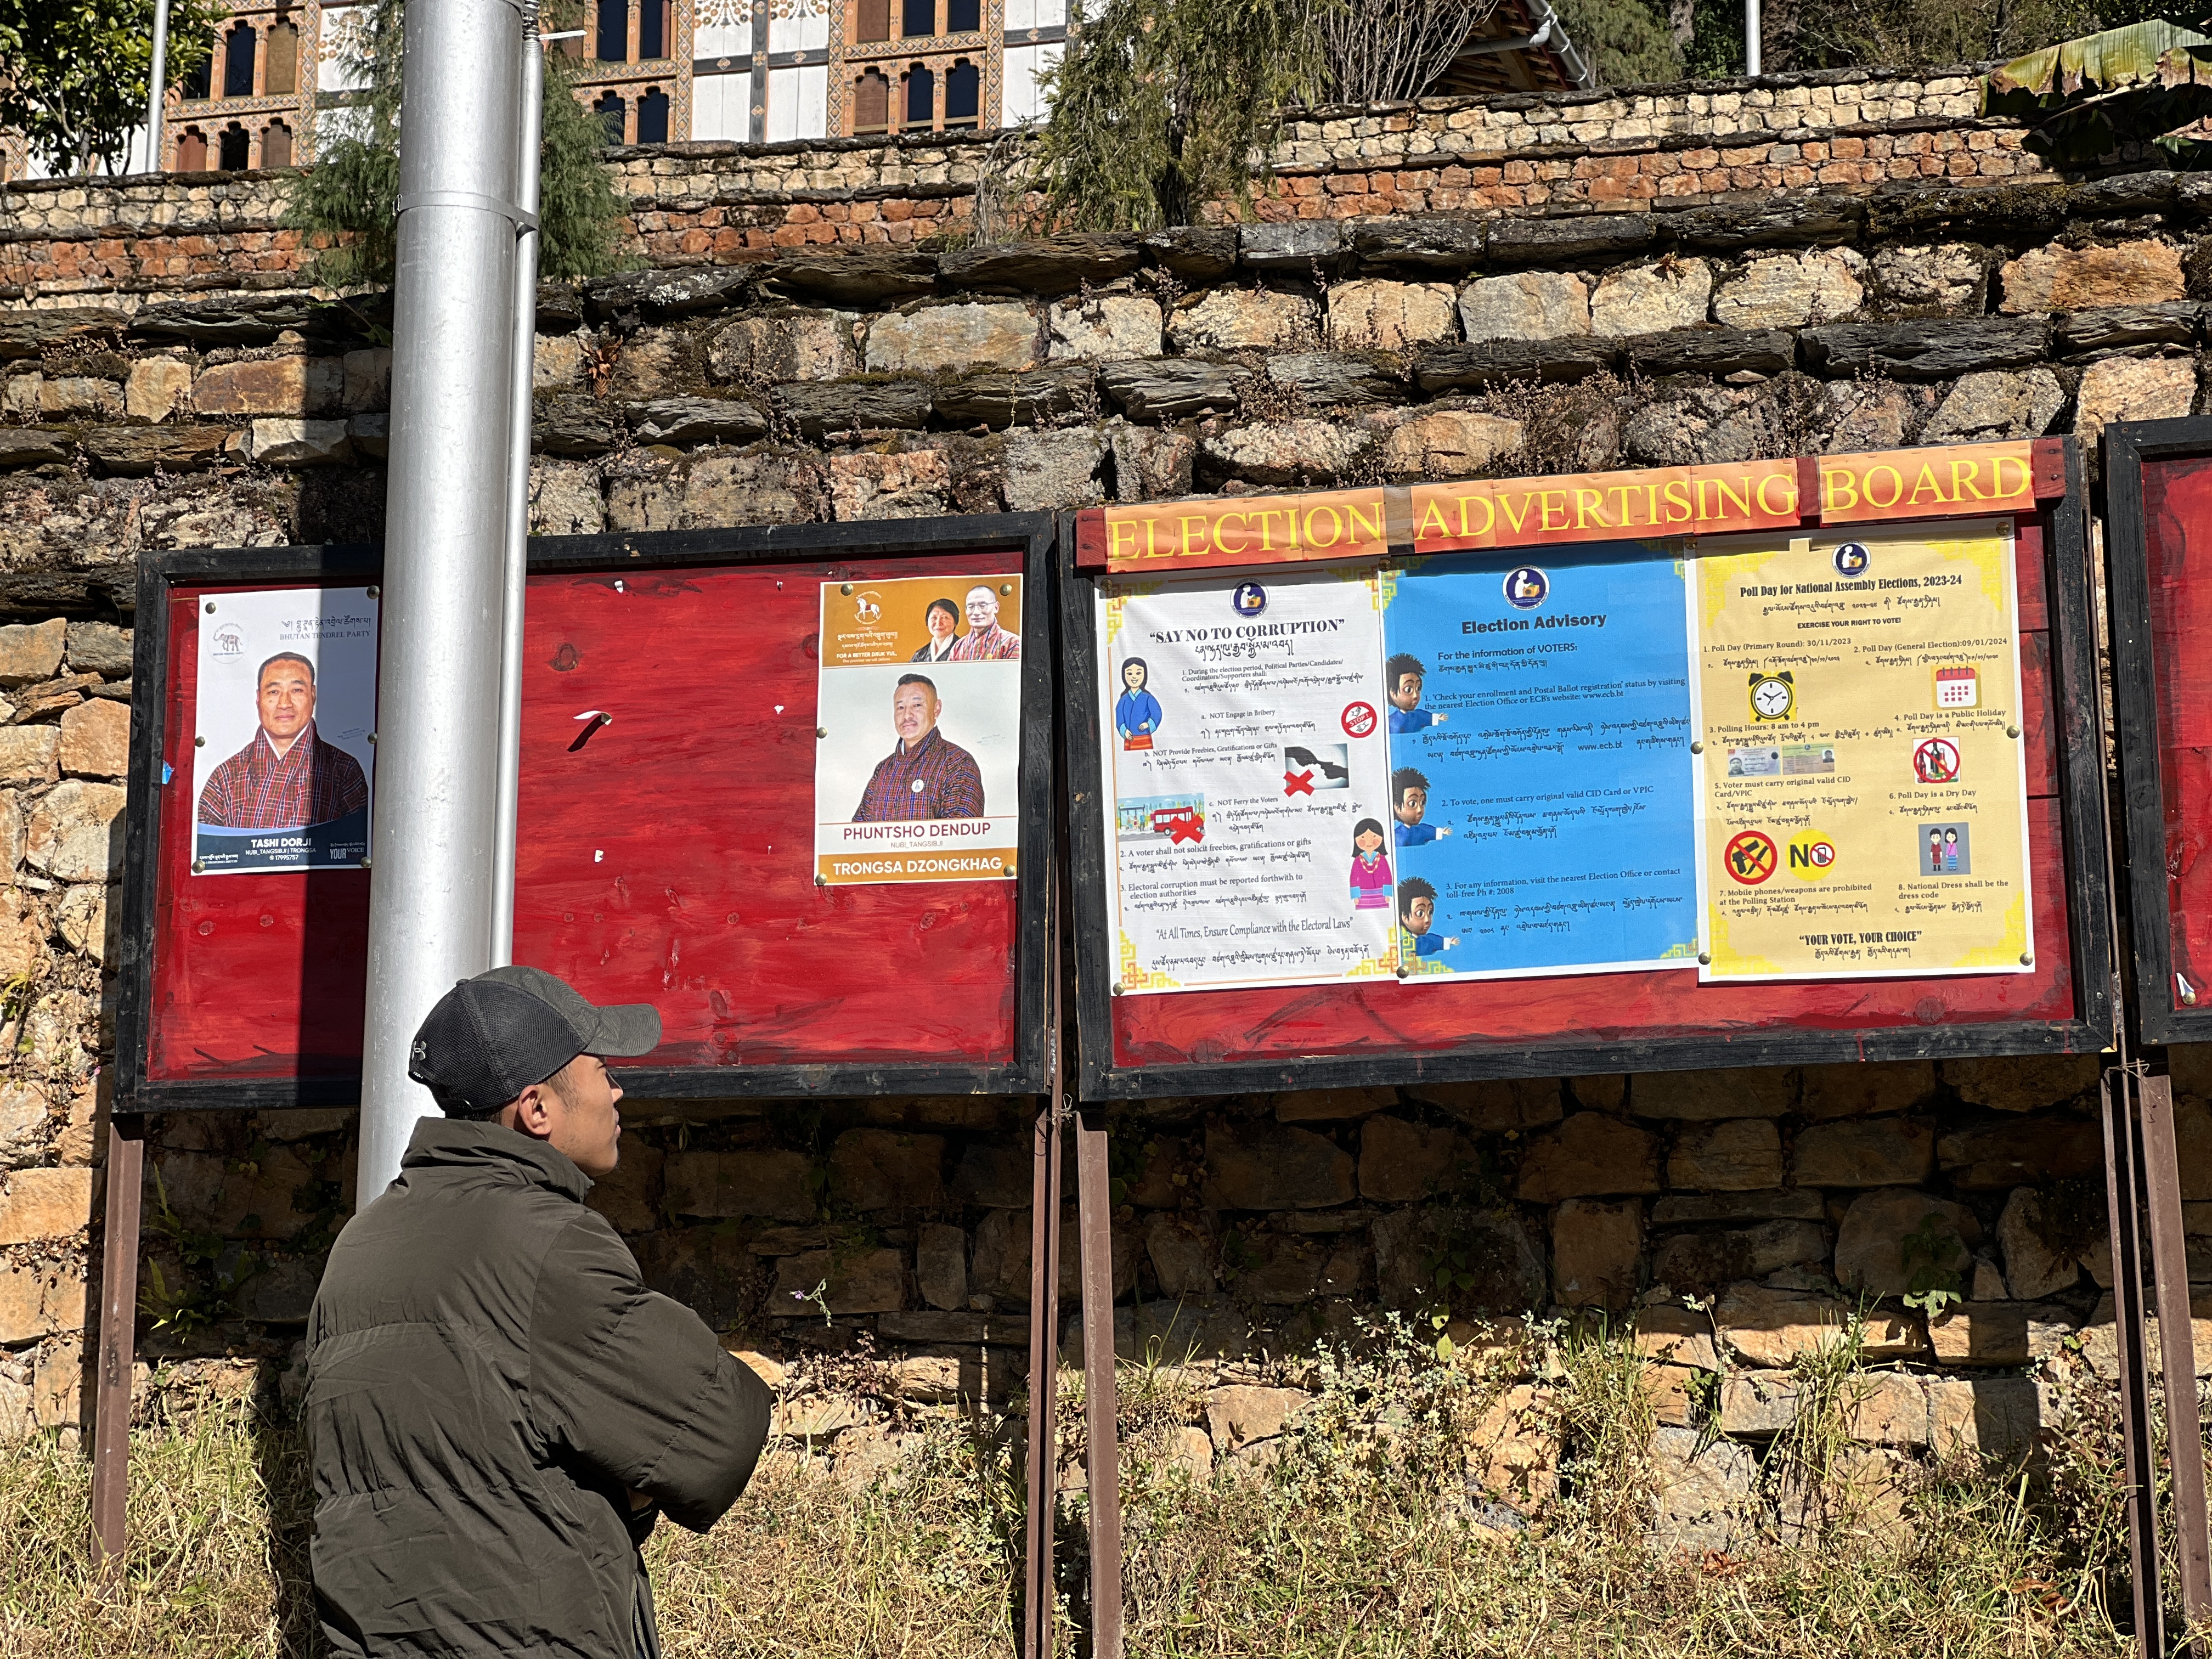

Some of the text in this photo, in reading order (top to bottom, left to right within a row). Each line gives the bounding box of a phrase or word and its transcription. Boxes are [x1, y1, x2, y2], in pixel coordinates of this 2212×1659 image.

[1109, 456, 2031, 560] ELECTION ADVERTISING BOARD
[1740, 574, 1962, 597] Poll Day for National Assembly Elections, 2023-24
[1462, 614, 1607, 634] Election Advisory
[312, 631, 345, 640] TENDREL
[1186, 629, 1207, 641] NO
[1210, 627, 1232, 640] TO
[1776, 640, 1804, 648] Round):
[1807, 637, 1851, 647] 30/11/2023
[1894, 641, 1926, 651] (General
[1928, 637, 2007, 648] Election):09/01/2024
[1438, 642, 1577, 661] For the information of VOTERS:
[1458, 693, 1476, 701] your
[1477, 689, 1517, 698] enrollment
[1534, 686, 1555, 694] Postal
[1558, 684, 1578, 693] Ballot
[1647, 679, 1657, 688] by
[1658, 678, 1685, 686] visiting
[1717, 725, 1743, 733] Polling
[1577, 740, 1623, 751] www.ecb.bt
[1536, 791, 1564, 802] original
[1566, 790, 1584, 798] valid
[1603, 788, 1622, 796] Card
[1632, 785, 1654, 793] VPIC
[844, 822, 991, 840] PHUNTSHO DENDUP
[251, 838, 311, 848] TASHI DORJI
[890, 840, 943, 849] NUBI_TANGSIBJI
[1155, 847, 1171, 855] shall
[1187, 844, 1207, 853] solicit
[1209, 843, 1238, 851] freebies,
[1239, 840, 1285, 851] gratifications
[1296, 837, 1311, 848] gifts
[330, 848, 347, 859] YOUR
[832, 856, 1002, 875] TRONGSA DZONGKHAG
[1128, 882, 1159, 891] Electoral
[1160, 880, 1198, 890] corruption
[1229, 875, 1259, 887] reported
[1261, 872, 1294, 883] forthwith
[1907, 882, 1939, 890] National
[1159, 889, 1197, 898] authorities
[1754, 887, 1816, 896] phones/weapons
[1832, 883, 1872, 893] prohibited
[1168, 927, 1178, 939] All
[1180, 927, 1203, 939] Times,
[1203, 926, 1228, 937] Ensure
[1229, 923, 1271, 938] Compliance
[1271, 921, 1287, 933] with
[1288, 921, 1300, 932] the
[1301, 918, 1331, 931] Electoral
[1859, 932, 1883, 943] YOUR
